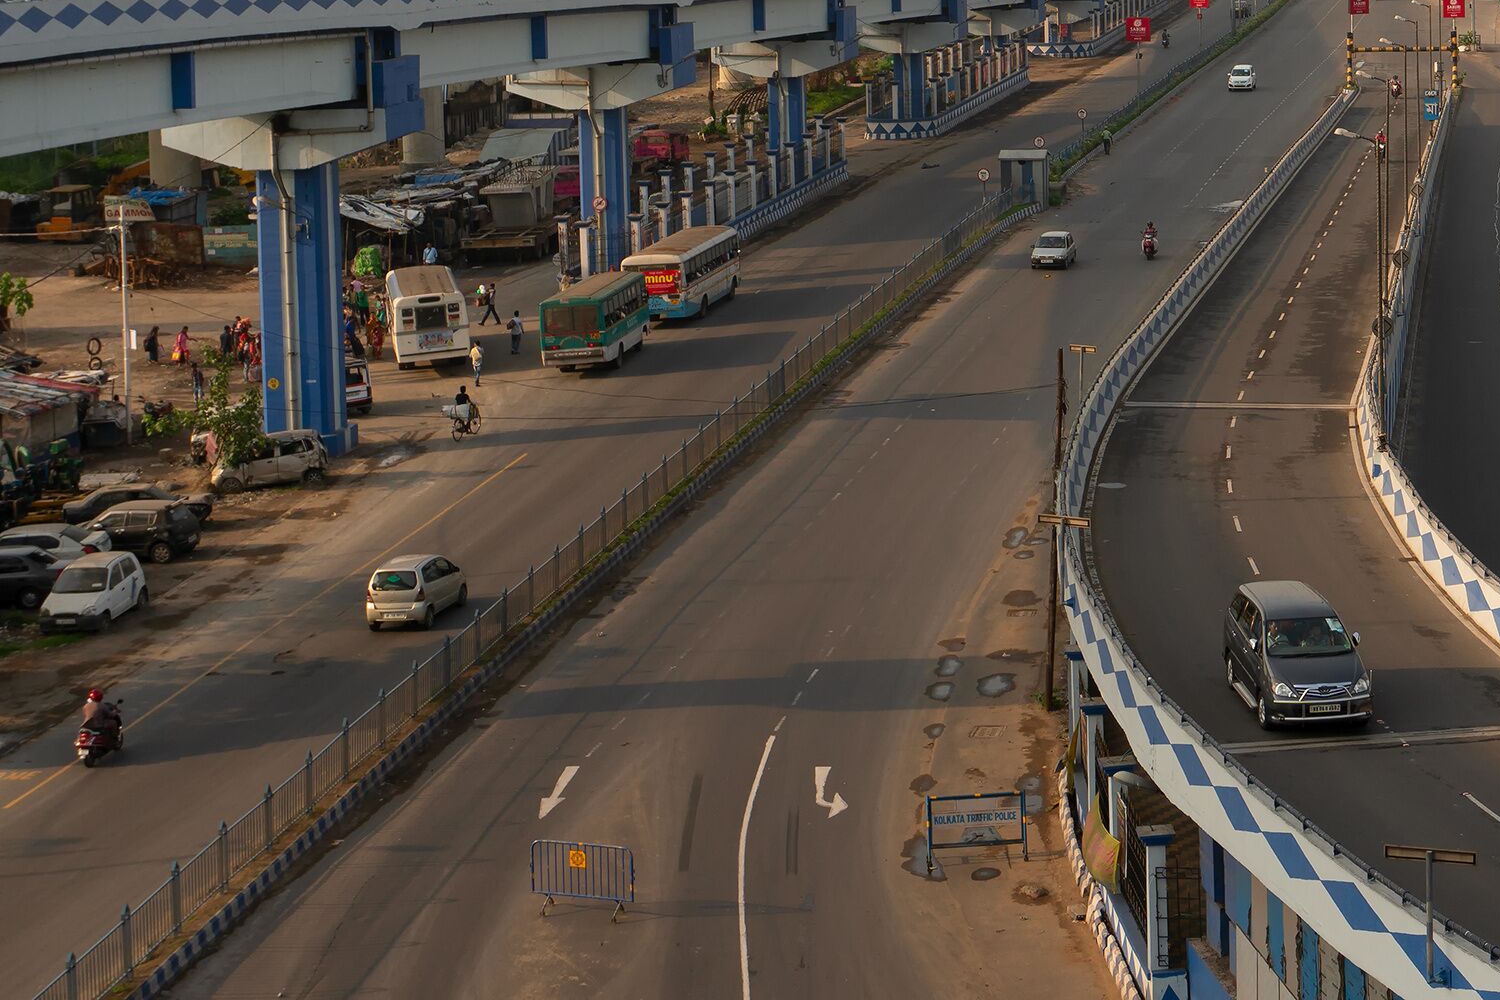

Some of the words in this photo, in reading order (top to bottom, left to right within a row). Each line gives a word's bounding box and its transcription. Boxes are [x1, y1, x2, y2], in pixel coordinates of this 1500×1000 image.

[933, 814, 965, 825] KOLKATA
[966, 812, 993, 823] TRAFFIC
[994, 811, 1017, 821] POLICE
